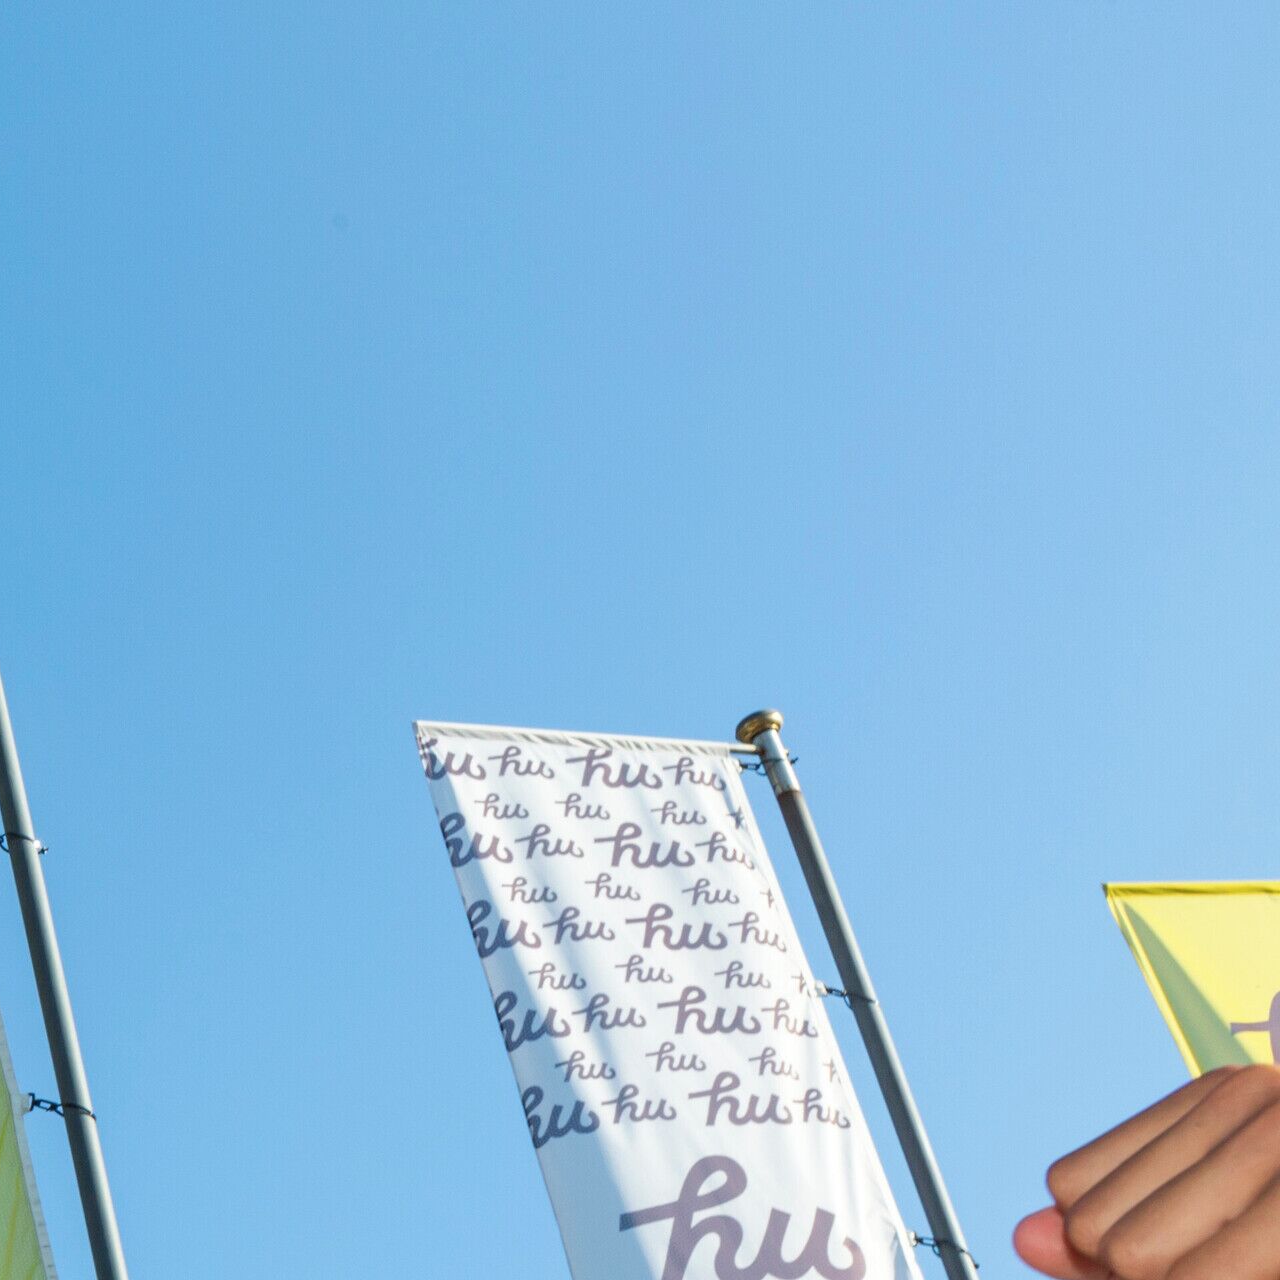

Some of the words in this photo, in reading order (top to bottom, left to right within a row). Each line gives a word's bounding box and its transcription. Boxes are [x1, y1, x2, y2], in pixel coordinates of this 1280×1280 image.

[488, 746, 555, 780] hu
[566, 748, 662, 789] hu
[663, 757, 727, 792] hu
[475, 793, 529, 820] hu
[555, 793, 610, 820] hu
[651, 801, 707, 827] hu
[515, 824, 584, 859] hu
[595, 823, 695, 868] hu
[696, 831, 755, 870] hu
[502, 877, 557, 904] hu
[585, 873, 640, 900] hu
[682, 878, 739, 906] hu
[543, 907, 615, 945] hu
[626, 904, 728, 950] hu
[728, 912, 787, 953] hu
[529, 963, 586, 991] hu
[615, 955, 673, 984] hu
[714, 961, 771, 989] hu
[572, 994, 646, 1033] hu
[658, 986, 761, 1037] hu
[761, 999, 818, 1038] hu
[555, 1051, 616, 1083] hu
[646, 1042, 706, 1072] hu
[749, 1047, 799, 1081] hu
[602, 1085, 676, 1124] hu
[689, 1072, 792, 1127] hu
[793, 1089, 850, 1129] hu
